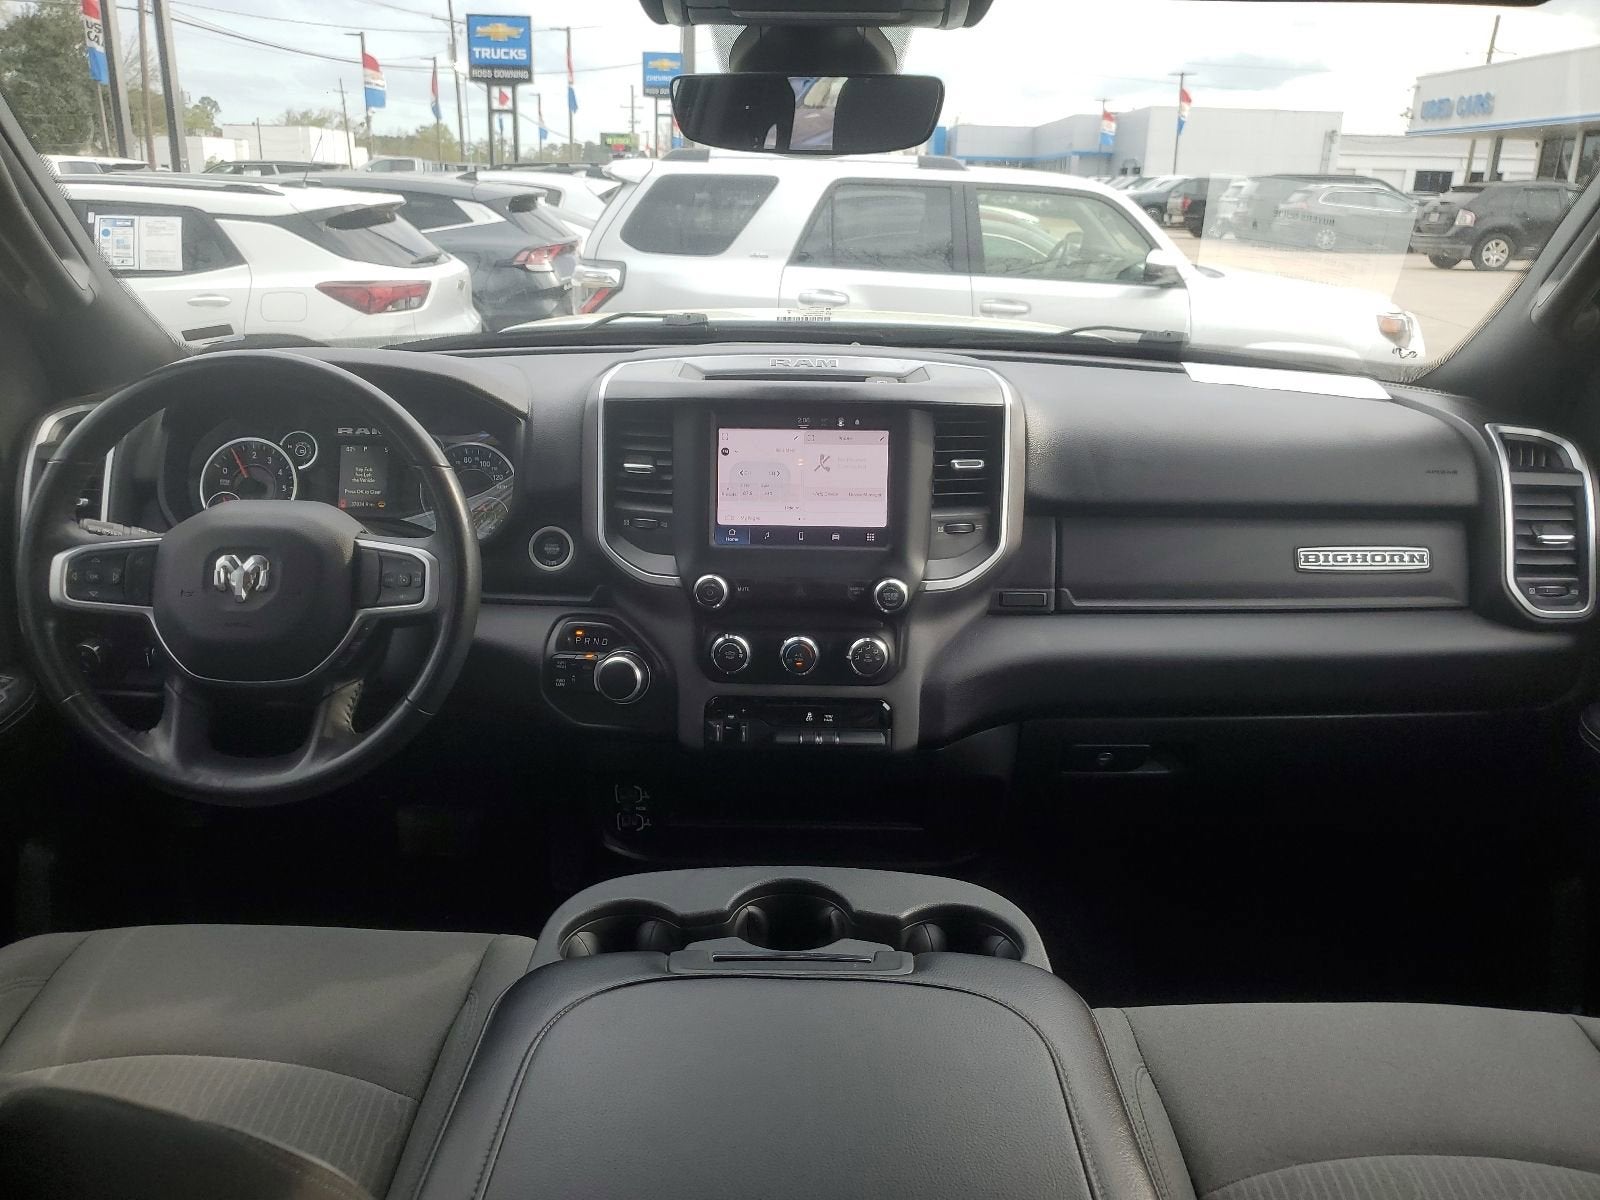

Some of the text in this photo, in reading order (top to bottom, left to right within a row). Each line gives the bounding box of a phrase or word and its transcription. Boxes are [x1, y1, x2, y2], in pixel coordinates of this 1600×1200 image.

[473, 47, 527, 60] TRUCKS
[1421, 92, 1495, 119] USED CARS
[769, 358, 839, 368] RAM
[267, 456, 272, 464] 3
[463, 456, 472, 464] 80
[480, 460, 491, 468] 100
[1301, 553, 1427, 564] BIGHORN
[601, 638, 608, 646] D
